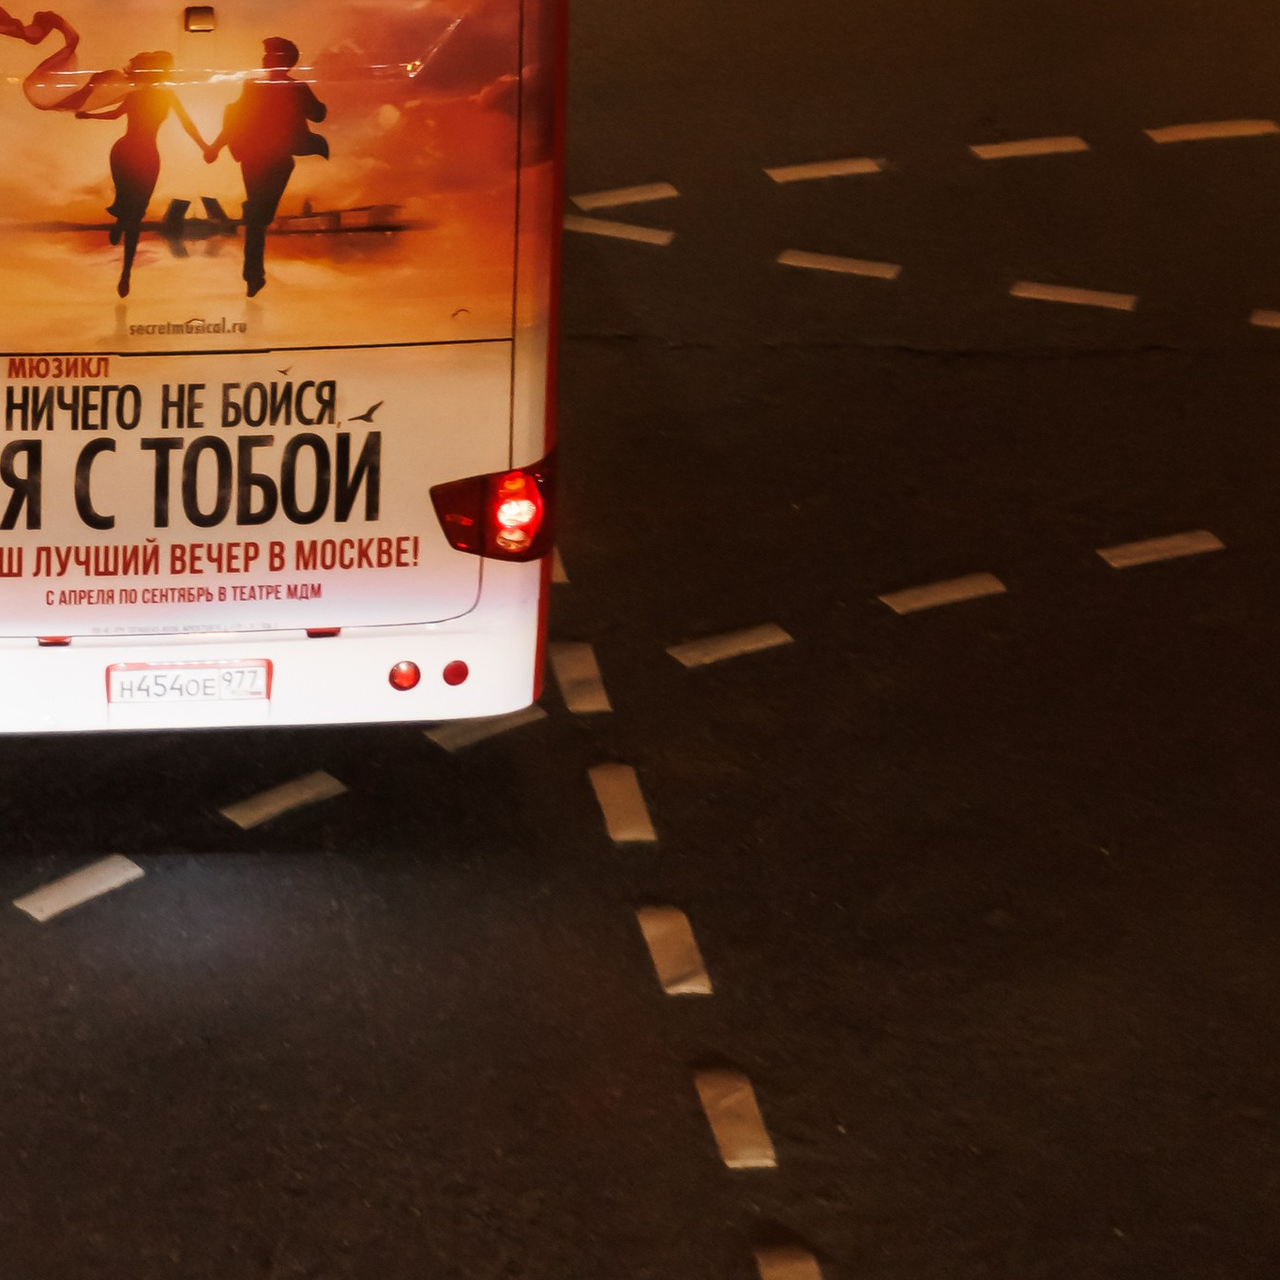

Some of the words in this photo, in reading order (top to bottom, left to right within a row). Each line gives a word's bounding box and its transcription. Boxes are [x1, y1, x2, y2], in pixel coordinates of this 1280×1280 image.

[129, 317, 247, 336] secretmusical.ru
[7, 357, 109, 380] МЮЗИКЛ
[5, 384, 141, 431] НИЧЕГО
[161, 383, 206, 428] НЕ
[0, 439, 42, 530] Я
[74, 437, 116, 530] С
[32, 538, 160, 577] ЛУЧШИЙ
[170, 541, 260, 575] ВЕЧЕР
[268, 540, 286, 571] В
[295, 536, 419, 570] МОСКВЕ!
[46, 590, 55, 605] С
[58, 589, 115, 605] АПРЕЛЯ
[120, 588, 138, 604] ПО
[141, 586, 214, 603] СЕНТЯБРЬ
[218, 586, 227, 602] В
[231, 584, 282, 601] ТЕАТРЕ
[286, 583, 322, 600] МДМ
[120, 674, 216, 698] Н454ОЕ
[222, 670, 258, 689] 977
